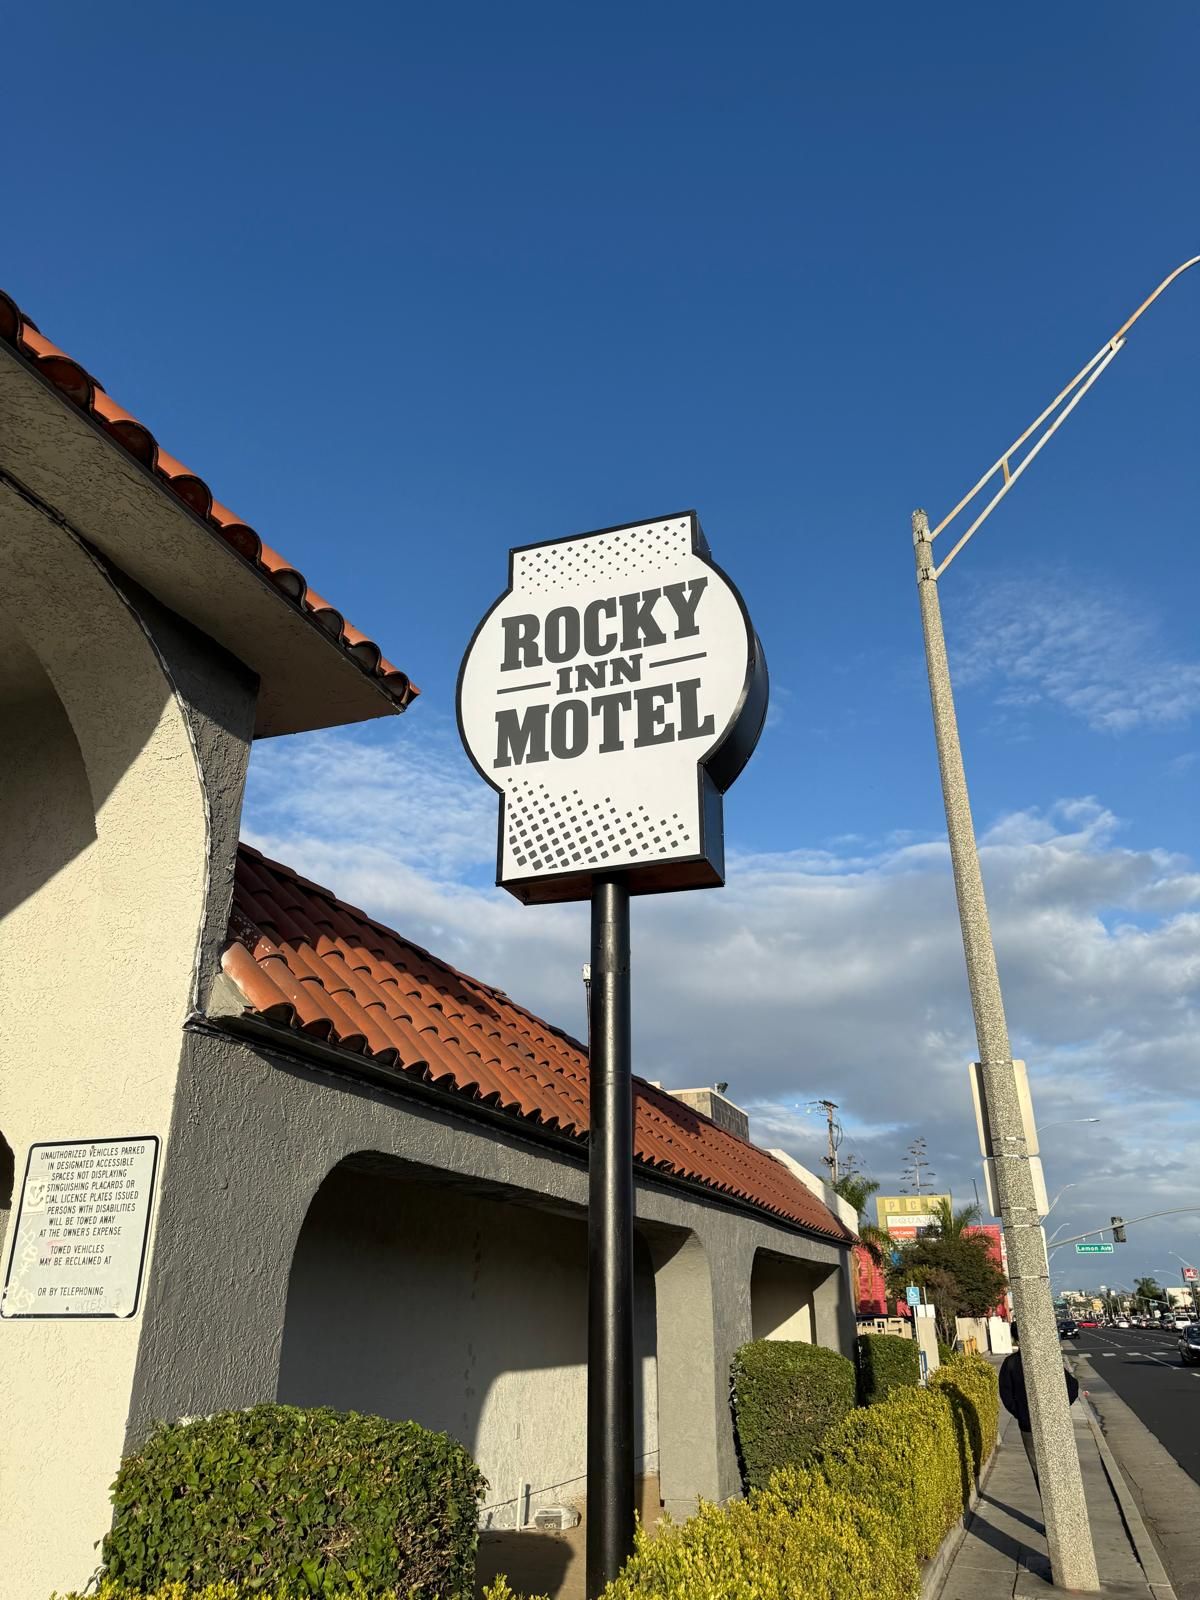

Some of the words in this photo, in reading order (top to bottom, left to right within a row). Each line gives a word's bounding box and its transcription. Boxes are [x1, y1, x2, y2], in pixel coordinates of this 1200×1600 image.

[500, 577, 708, 672] ROCKY
[556, 653, 643, 695] INN
[493, 677, 715, 769] MOTEL
[41, 1150, 86, 1160] UNAUTHORIZED
[90, 1147, 119, 1157] VEHICLES
[121, 1146, 145, 1155] PARKED
[48, 1162, 55, 1170] IN
[57, 1160, 94, 1170] DESIGNATED
[96, 1158, 134, 1167] ACCESSIBLE
[52, 1172, 74, 1181] SPACES
[77, 1170, 90, 1179] NOT
[91, 1169, 127, 1178] DISPLAYING
[46, 1182, 89, 1192] STINGUISHING
[92, 1181, 124, 1190] PLACARDS
[126, 1180, 135, 1188] OR
[61, 1193, 86, 1203] LICENSE
[90, 1193, 113, 1201] PLATES
[116, 1191, 139, 1200] ISSUED
[47, 1206, 76, 1214] PERSONS
[79, 1205, 93, 1214] WITH
[96, 1203, 136, 1212] DISABILITIES
[49, 1217, 62, 1225] WILL
[65, 1217, 74, 1225] BE
[76, 1216, 97, 1225] TOWED
[99, 1215, 115, 1224] AWAY
[39, 1229, 47, 1237] AT
[49, 1229, 60, 1237] THE
[93, 1227, 122, 1236] EXPENSE
[50, 1246, 71, 1254] TOWED
[74, 1245, 105, 1254] VEHICLES
[39, 1257, 51, 1266] MAY
[54, 1257, 64, 1265] BE
[66, 1256, 102, 1265] RECLAIMED
[104, 1256, 112, 1264] AT
[37, 1288, 48, 1296] OR
[50, 1288, 58, 1296] BY
[61, 1287, 104, 1295] TELEPHONING
